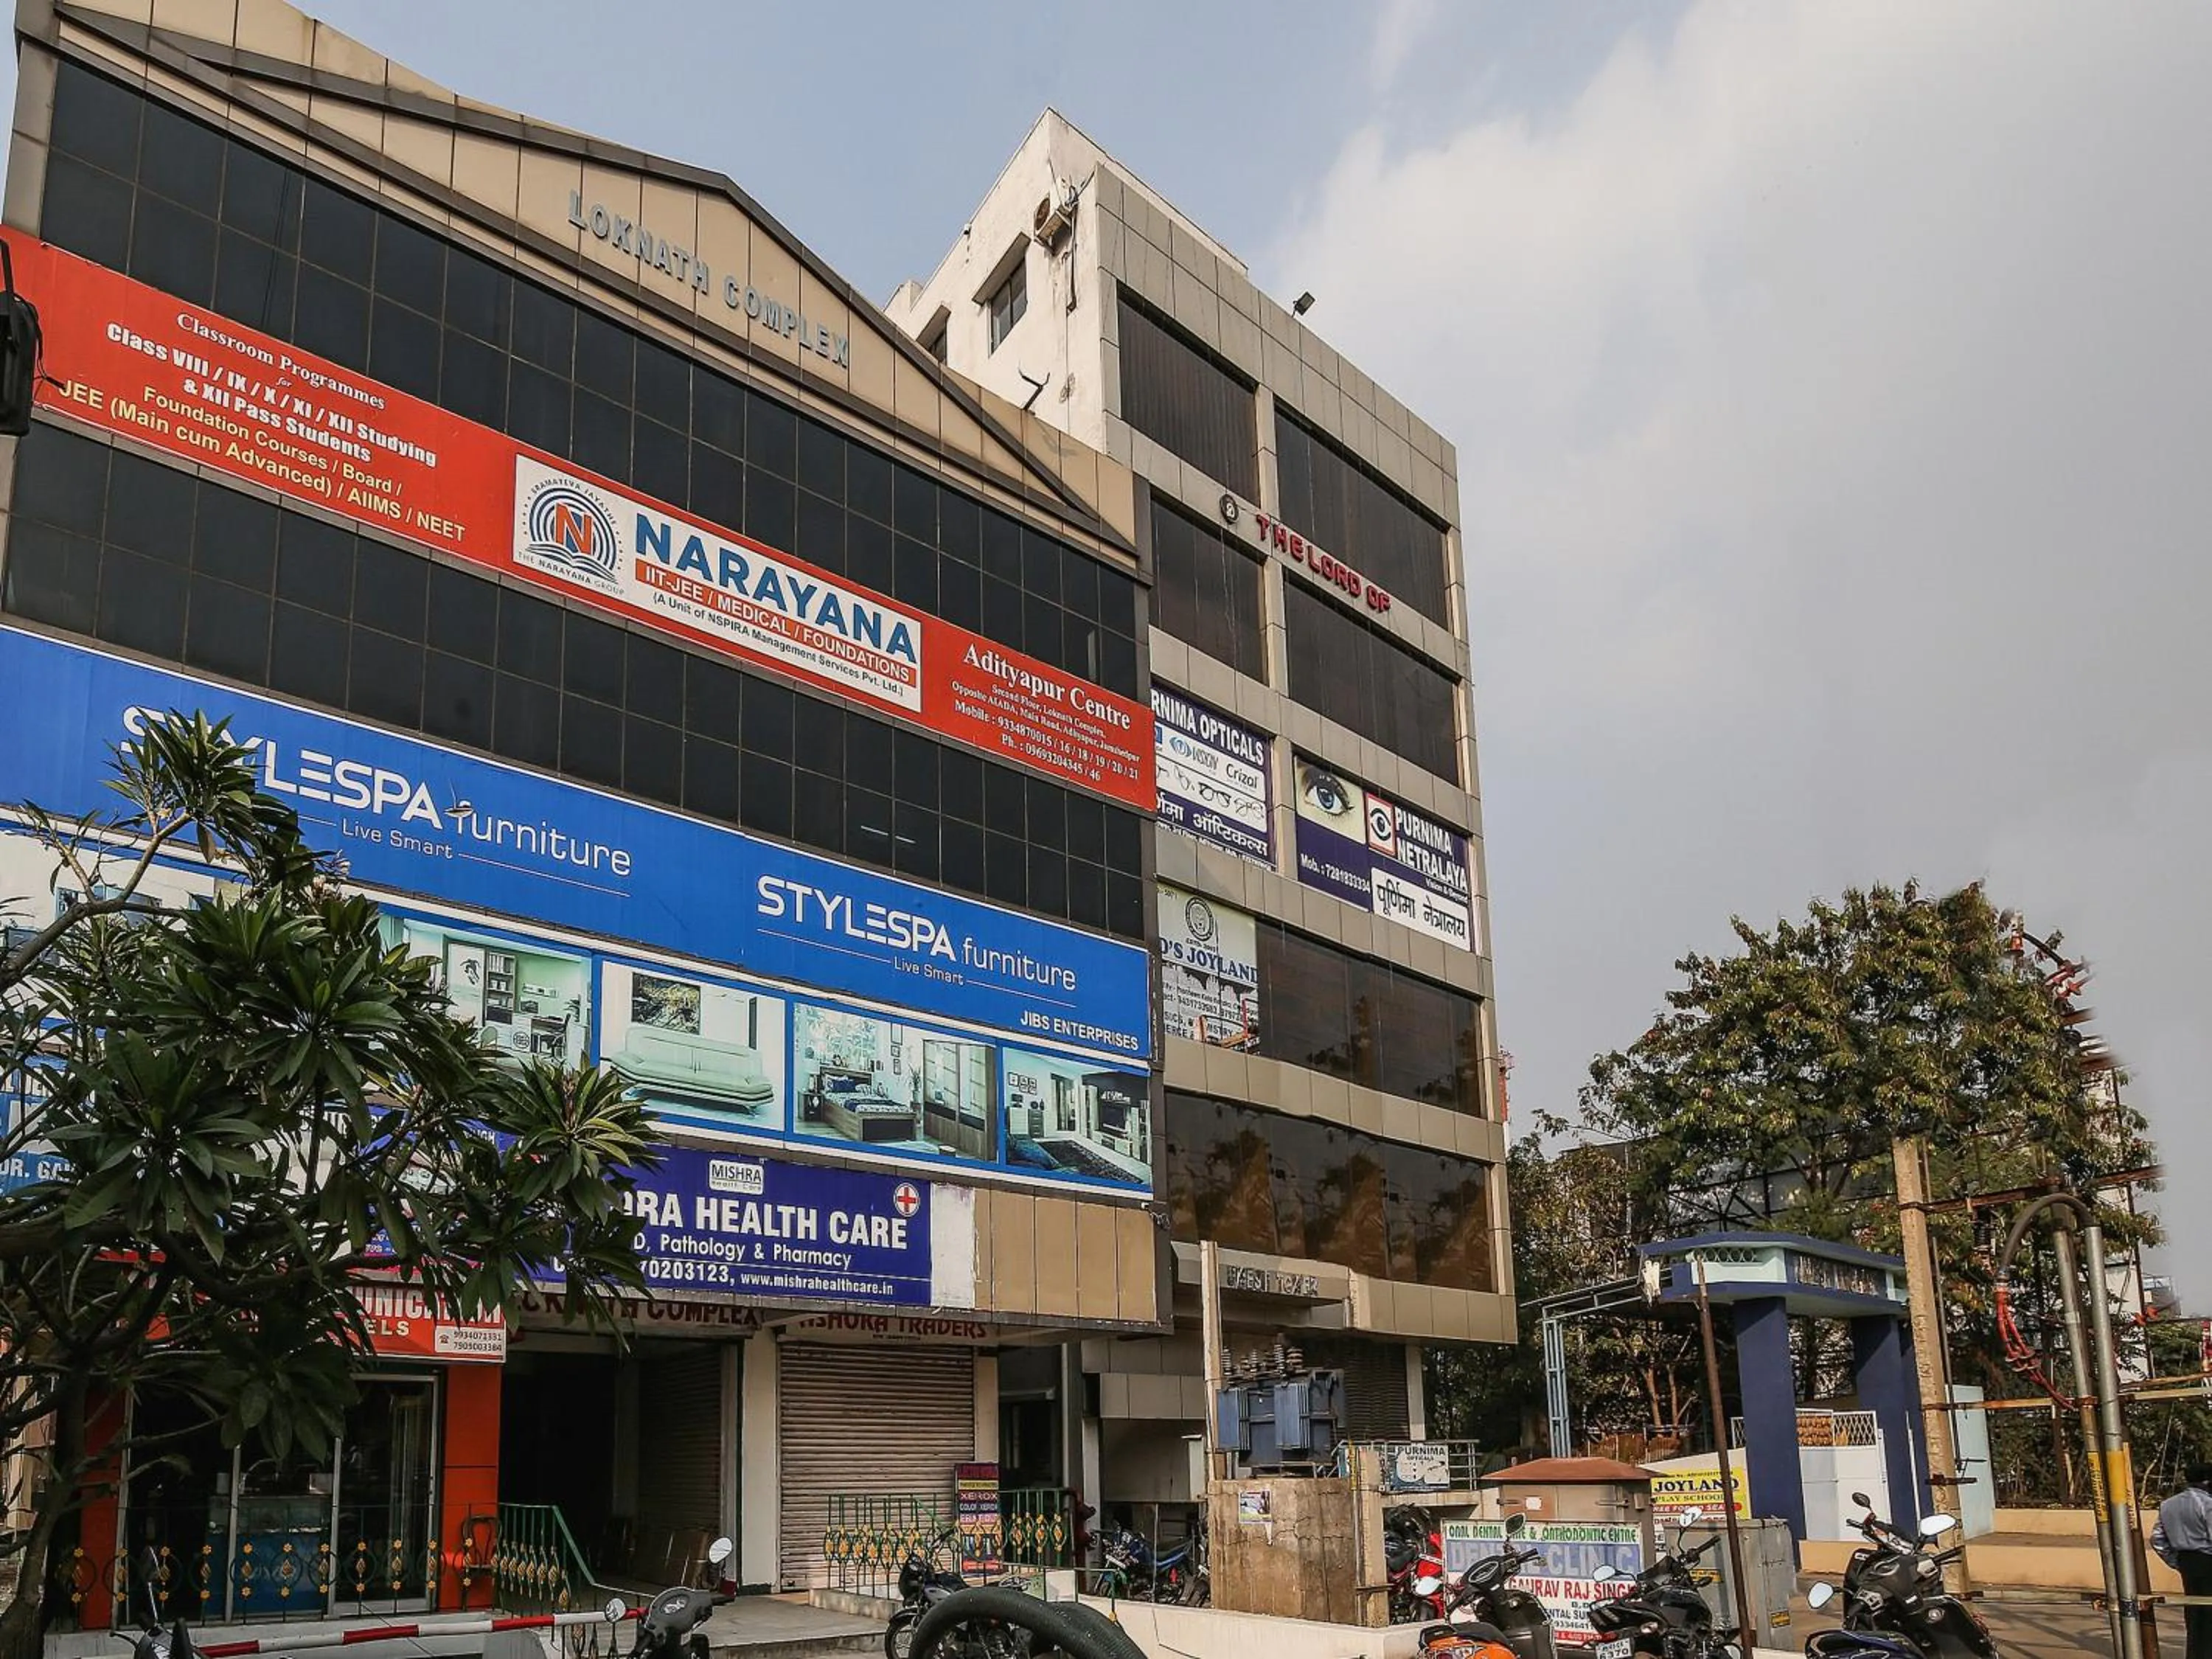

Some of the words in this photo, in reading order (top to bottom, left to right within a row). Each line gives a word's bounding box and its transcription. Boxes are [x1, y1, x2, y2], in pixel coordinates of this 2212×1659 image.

[567, 189, 709, 295] LOKNATH
[722, 274, 849, 369] COMPLEX
[176, 313, 274, 365] Classroom
[279, 355, 386, 411] Programmes
[275, 377, 291, 388] for
[107, 323, 167, 362] Class
[172, 349, 209, 376] VIII
[226, 371, 247, 393] IX
[262, 385, 278, 405] X
[293, 396, 312, 418] XI
[327, 410, 354, 436] XII
[357, 422, 437, 467] Studying
[183, 378, 198, 394] &
[201, 383, 230, 410] XII
[234, 394, 281, 431] Pass
[285, 412, 370, 462] Students
[59, 380, 103, 411] JEE
[110, 395, 170, 436] (Main
[175, 424, 220, 453] cum
[225, 443, 333, 498] Advanced)
[347, 486, 402, 519] AIIMS
[417, 512, 466, 543] NEET
[144, 386, 249, 440] Foundation
[254, 429, 327, 471] Courses
[342, 462, 392, 495] Board
[635, 512, 917, 664] NARAYANA
[1256, 514, 1304, 563] THE
[1308, 546, 1362, 598] LORD
[1366, 585, 1391, 613] OF
[644, 566, 703, 602] IIT-JEE
[717, 594, 791, 637] MEDICAL
[803, 627, 911, 683] FOUNDATIONS
[668, 594, 692, 616] Unit
[694, 603, 706, 619] of
[708, 609, 750, 637] NSPIRA
[751, 627, 816, 664] Management
[818, 651, 860, 681] Services
[862, 669, 879, 686] Pvt.
[955, 700, 990, 722] Mobile
[962, 642, 1065, 702] Adityapur
[1070, 687, 1131, 730] Centre
[1001, 734, 1018, 749] Ph.
[1200, 715, 1265, 768] OPTICALS
[122, 705, 442, 830] SLESPA
[453, 799, 632, 876] furniture
[1226, 763, 1258, 789] Crizal
[341, 818, 382, 844] Live
[389, 830, 453, 859] Smart
[1394, 807, 1453, 857] PURNIMA
[1397, 838, 1467, 892] NETRALAYA
[1377, 879, 1416, 919] पूर्णिमा
[757, 874, 956, 961] STYLESPA
[962, 937, 1077, 991] furniture
[894, 956, 919, 975] Live
[924, 963, 964, 986] Smart
[1020, 1010, 1050, 1031] JIBS
[1054, 1018, 1138, 1051] ENTERPRISES
[712, 1164, 762, 1182] MISHRA
[696, 1196, 818, 1241] HEALTH
[830, 1211, 908, 1250] CARE
[660, 1234, 745, 1262] Pathology
[754, 1242, 765, 1260] &
[774, 1245, 852, 1270] Pharmacy
[741, 1272, 893, 1295] www.mishrahealthcare.in
[900, 1318, 987, 1339] TRADERS
[1399, 1446, 1445, 1455] PURNIMA
[1565, 1579, 1590, 1599] RAJ
